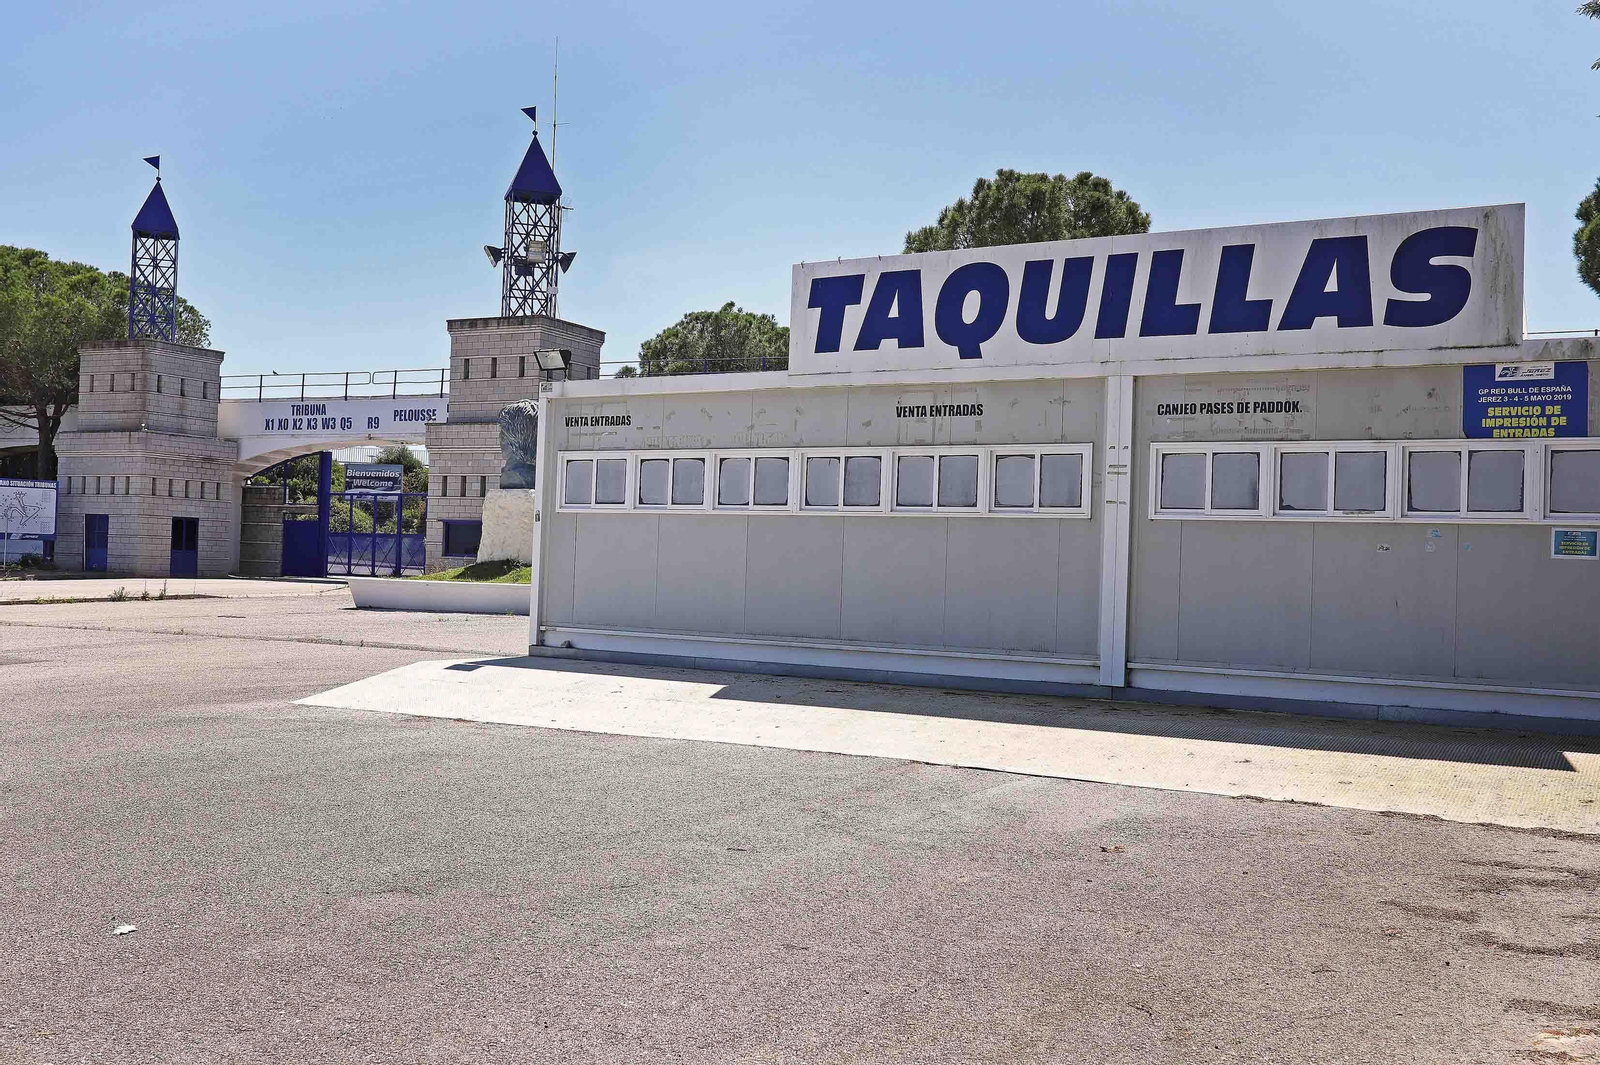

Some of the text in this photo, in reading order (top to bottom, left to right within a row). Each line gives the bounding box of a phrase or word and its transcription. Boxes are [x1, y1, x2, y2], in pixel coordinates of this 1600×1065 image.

[808, 226, 1478, 359] TAQUILLAS
[1541, 385, 1572, 393] ESPAÑA
[291, 403, 327, 416] TRIBUNA
[896, 404, 984, 418] VENTA ENTRADAS
[1157, 401, 1303, 416] CANJEO PASES DE PADDOK.
[1487, 405, 1561, 416] SERVICIO DE
[265, 418, 274, 430] X1
[292, 418, 303, 430] X2
[306, 418, 318, 430] X3
[321, 417, 336, 430] W3
[340, 417, 352, 430] Q5
[367, 416, 380, 429] R9
[565, 415, 632, 428] VENTA ENTRADAS
[1482, 415, 1567, 427] IMPRESIÓN DE
[1493, 428, 1555, 438] ENTRADAS
[346, 469, 400, 477] Bienvenidos
[353, 479, 393, 487] Welcome
